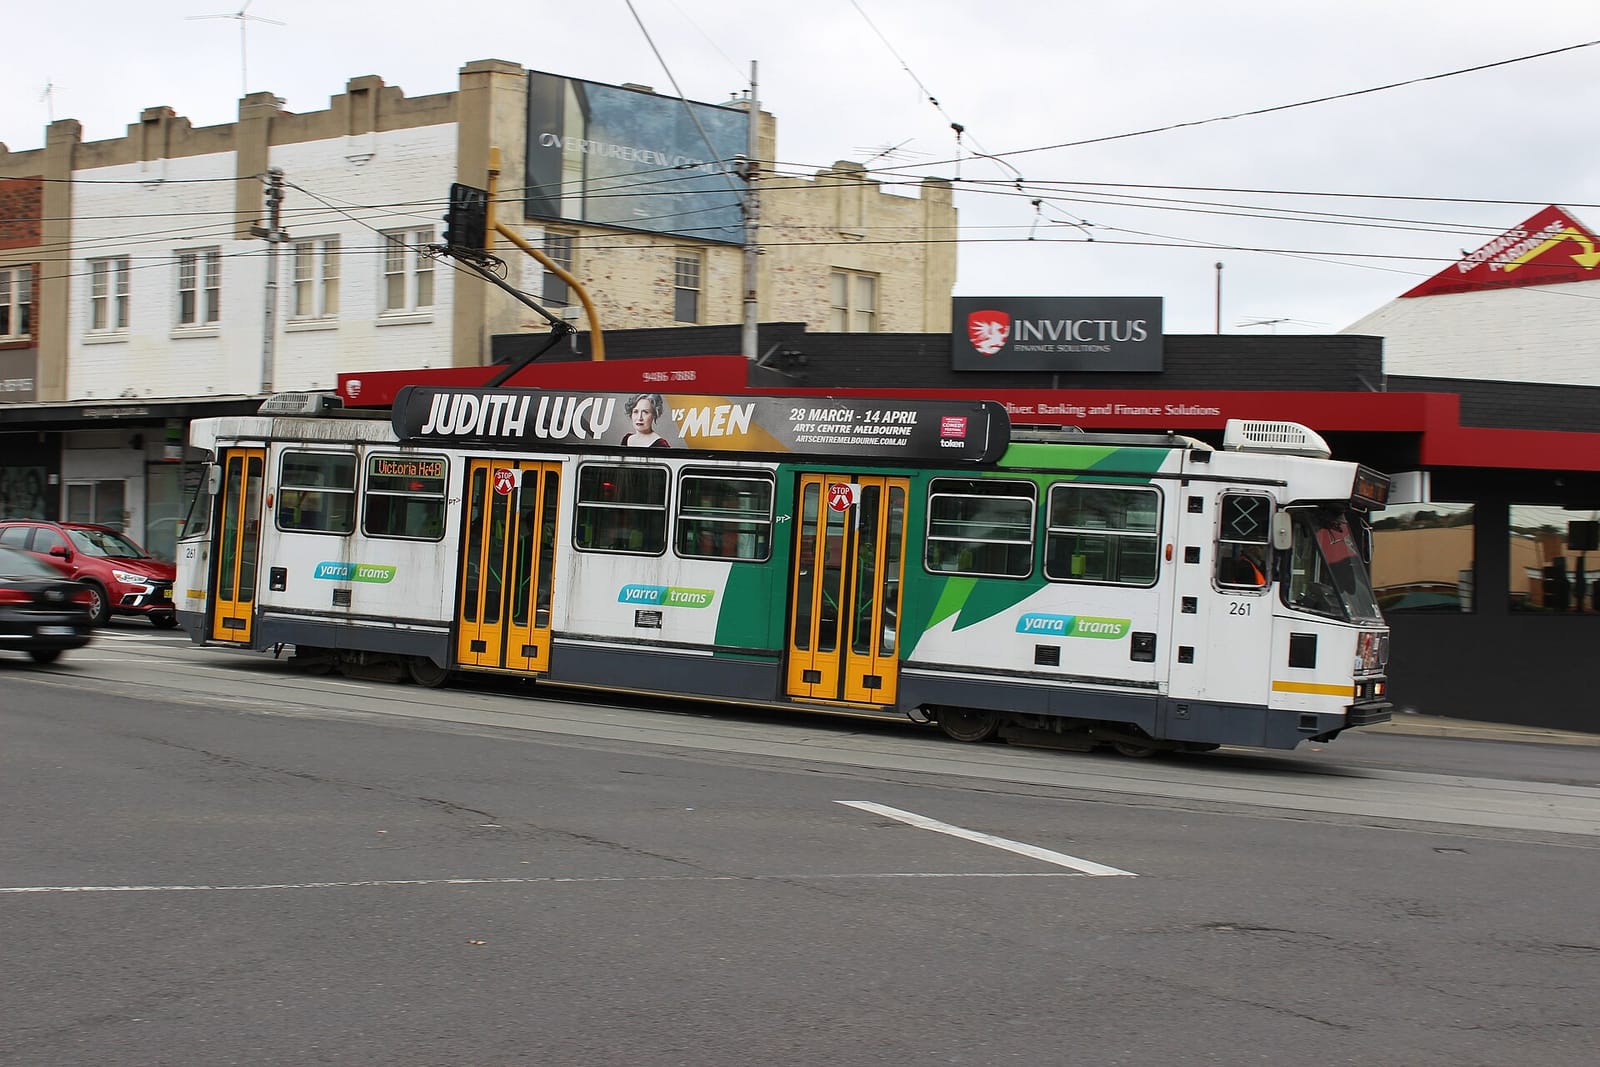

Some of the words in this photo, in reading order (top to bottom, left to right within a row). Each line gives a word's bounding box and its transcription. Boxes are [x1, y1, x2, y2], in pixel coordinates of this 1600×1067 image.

[1488, 219, 1565, 271] HARDWARE
[1014, 319, 1148, 342] INVICTUS
[1013, 344, 1055, 353] FINANCE
[1056, 344, 1112, 353] SOLUTIONS
[421, 393, 531, 437] JUDITH
[534, 396, 616, 440] LUCY
[671, 408, 686, 422] VS
[789, 408, 806, 421] 28
[808, 409, 854, 422] MARCH
[864, 410, 880, 423] 14
[881, 411, 917, 424] APRIL
[1037, 403, 1087, 418] Banking
[1088, 405, 1111, 415] and
[1114, 404, 1161, 416] Finance
[1164, 404, 1220, 416] Solutions
[678, 403, 756, 439] MEN
[793, 423, 815, 432] ARTS
[817, 424, 851, 434] CENTRE
[853, 425, 912, 436] MELBOURNE
[795, 435, 907, 446] ARTSCENTREMELBOURNE.COM.AU
[940, 439, 965, 448] token
[378, 459, 417, 476] Victoria
[496, 471, 512, 480] STOP
[831, 486, 849, 495] STOP
[320, 565, 348, 577] yarra
[358, 567, 389, 579] trams
[625, 588, 658, 600] yarra
[670, 590, 707, 604] trams
[1229, 601, 1251, 616] 261
[1024, 617, 1063, 631] yarra
[1078, 619, 1122, 634] trams
